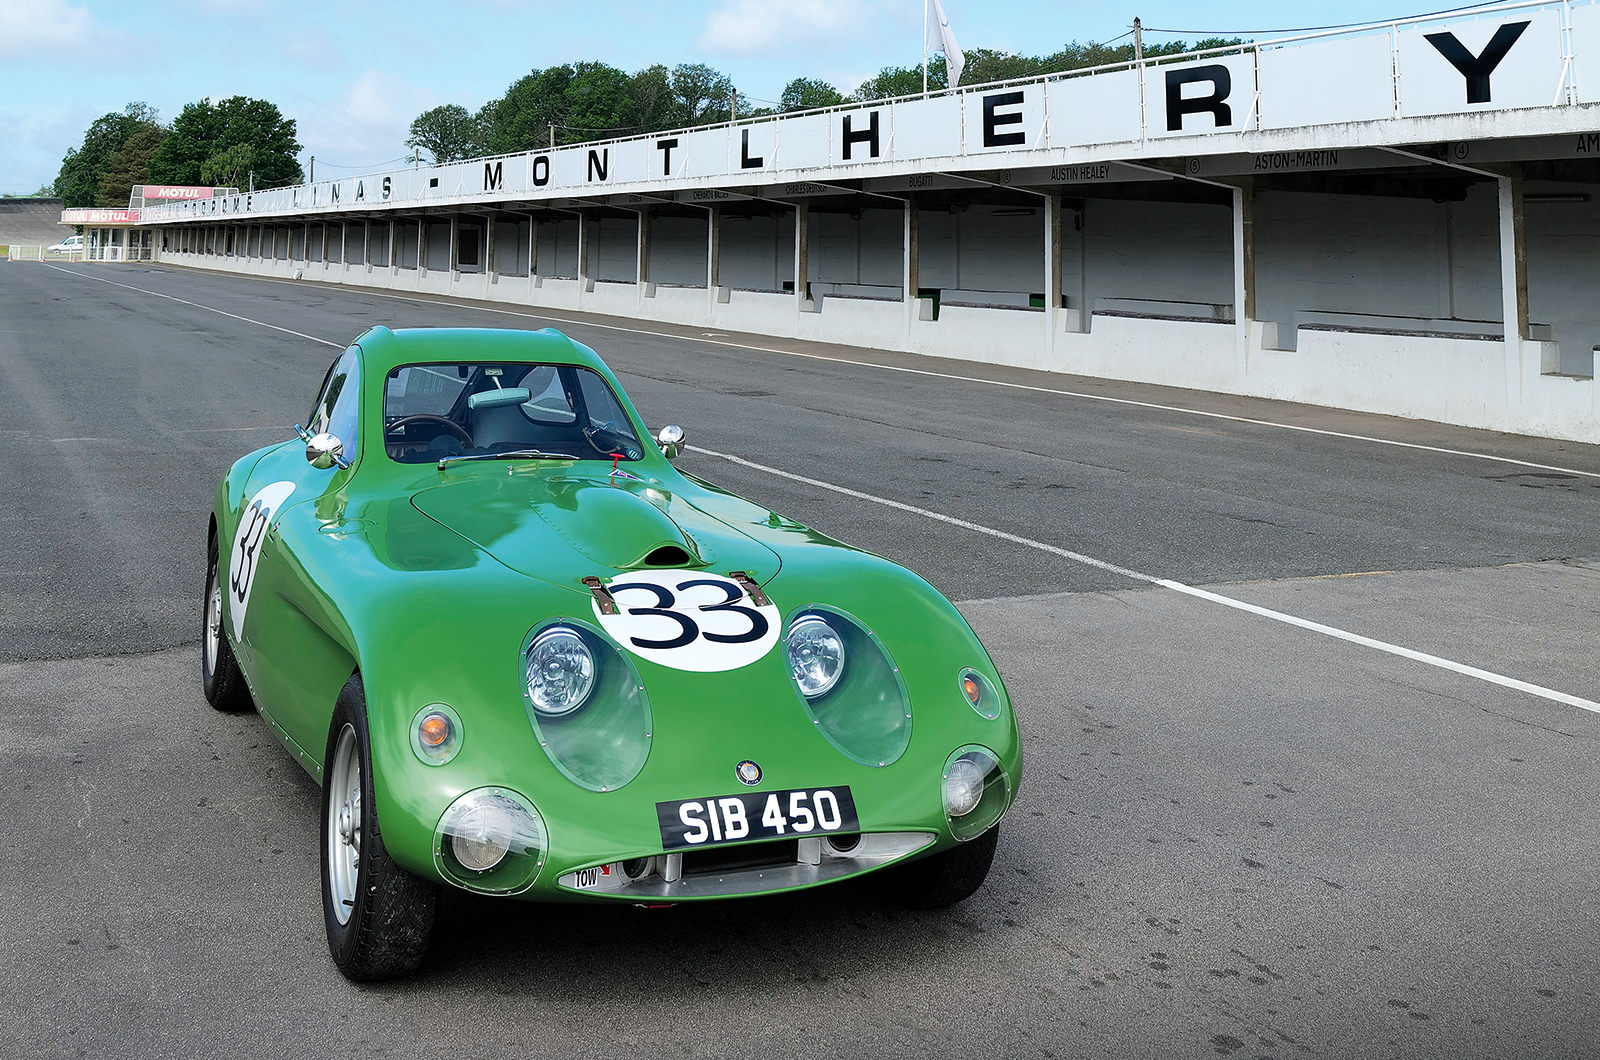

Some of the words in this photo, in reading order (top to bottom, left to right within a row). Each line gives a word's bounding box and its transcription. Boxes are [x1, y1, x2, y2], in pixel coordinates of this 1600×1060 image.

[293, 176, 392, 208] LINAS
[484, 20, 1530, 191] MONTLHERY
[1576, 133, 1600, 153] AM
[1254, 150, 1338, 170] ASTON-MARTIN
[909, 175, 933, 188] BUGATTI
[1051, 167, 1078, 181] AUSTIN
[1080, 165, 1110, 180] HEALEY
[158, 187, 200, 198] MOTUL
[785, 183, 806, 195] CHARLES
[90, 210, 127, 221] MOTUL
[231, 499, 270, 604] 33
[607, 579, 769, 650] 33
[678, 797, 750, 845] SIB
[761, 789, 842, 835] 450
[575, 868, 598, 887] TOW
